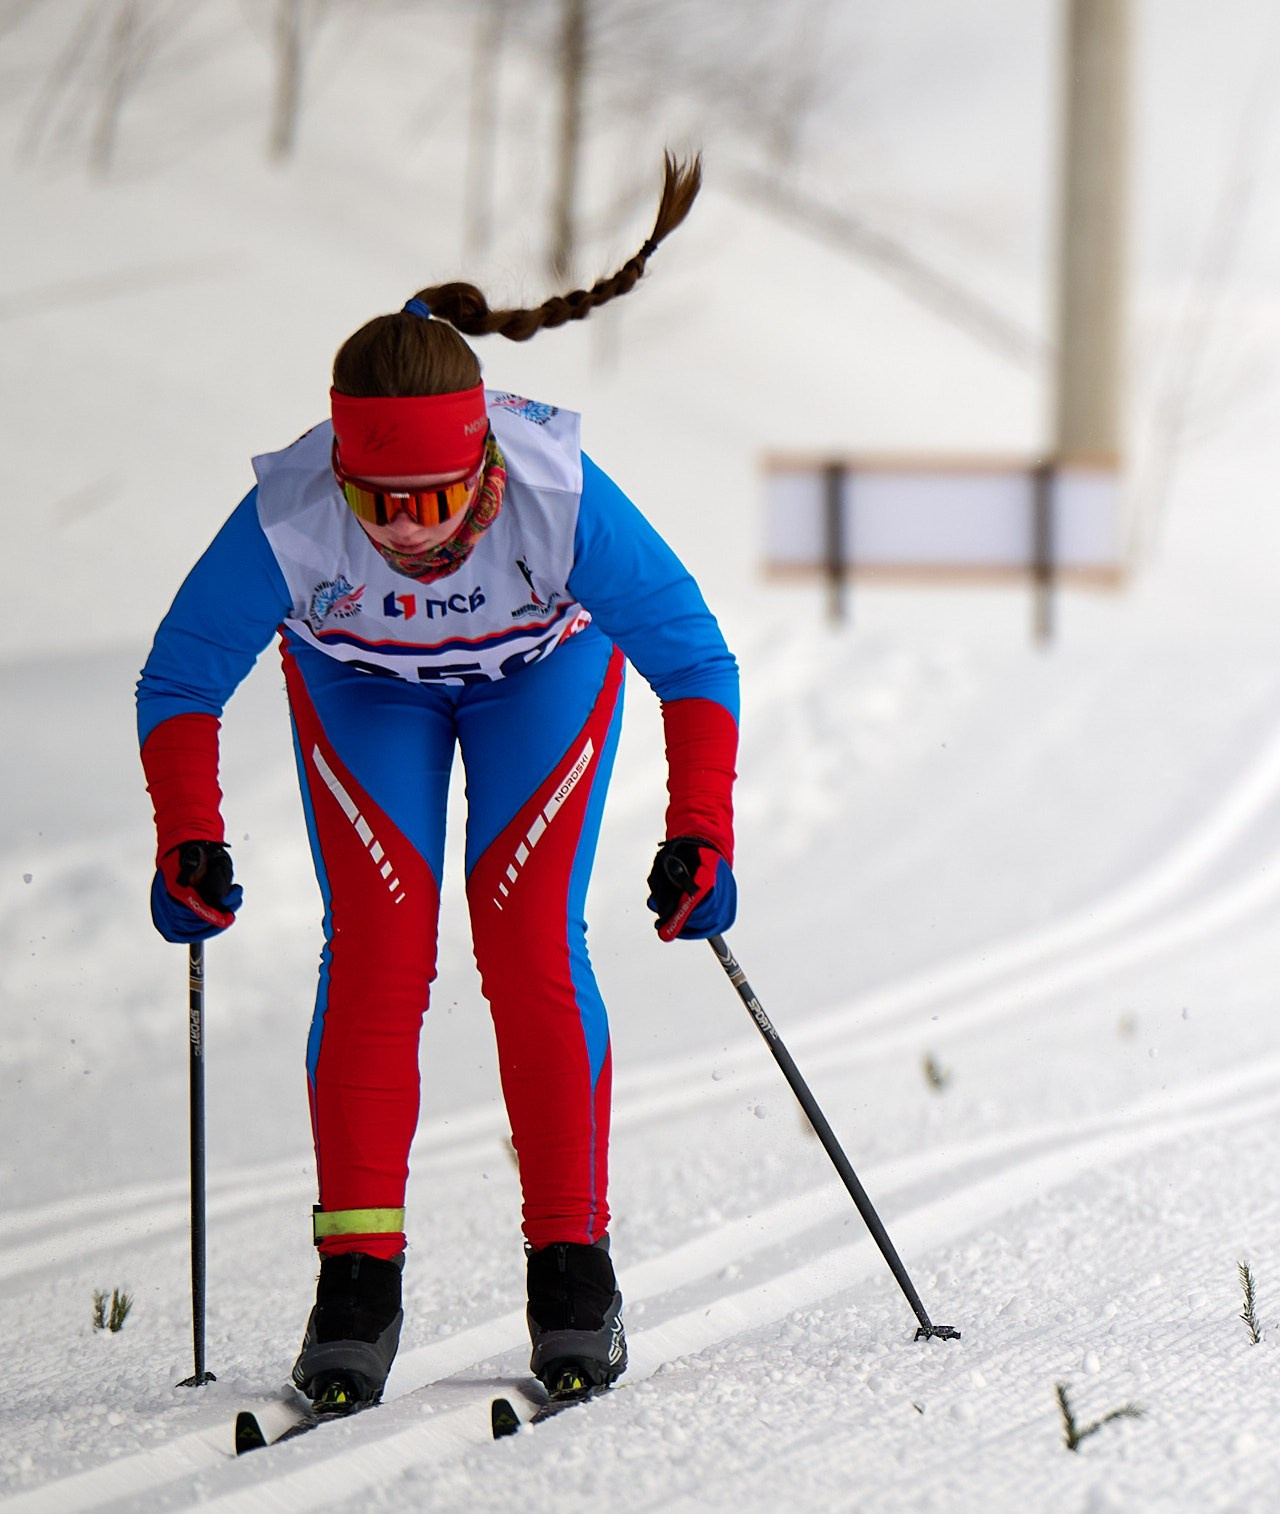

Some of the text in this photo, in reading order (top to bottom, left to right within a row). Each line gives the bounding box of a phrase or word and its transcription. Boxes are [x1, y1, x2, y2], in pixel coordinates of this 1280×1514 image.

[426, 587, 486, 620] ПСБ
[554, 754, 589, 802] NORDSKI
[190, 1008, 200, 1044] SPORT
[747, 998, 772, 1032] SPORT
